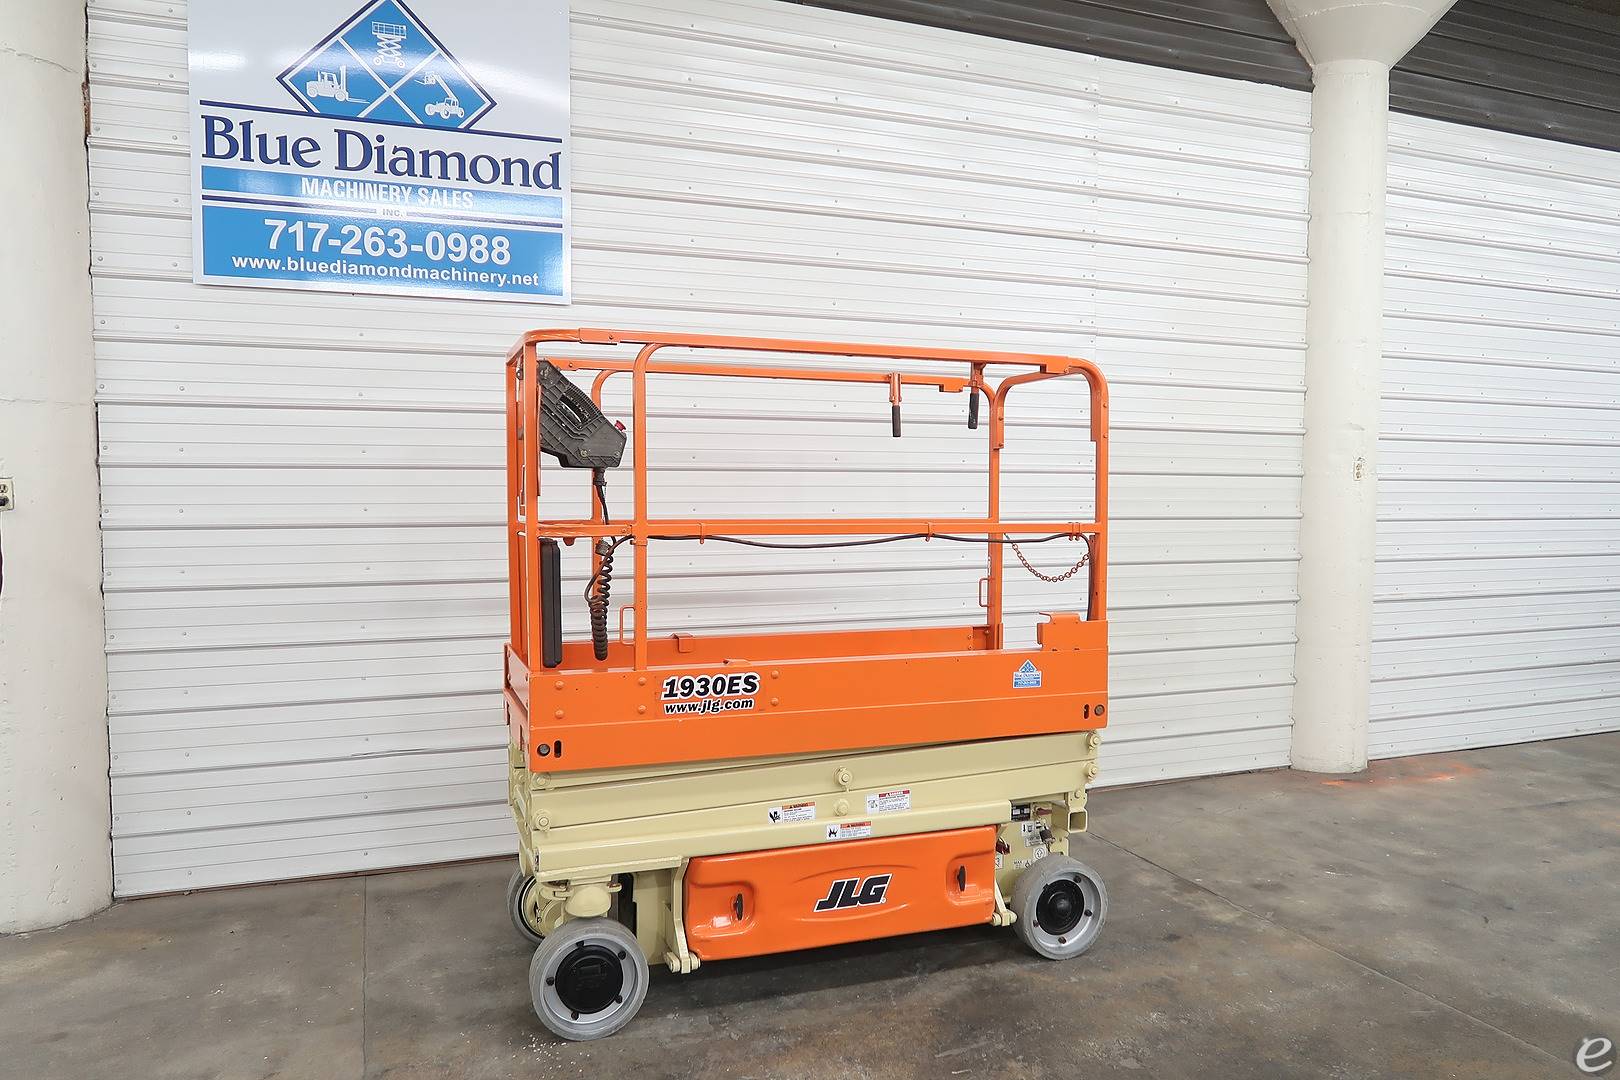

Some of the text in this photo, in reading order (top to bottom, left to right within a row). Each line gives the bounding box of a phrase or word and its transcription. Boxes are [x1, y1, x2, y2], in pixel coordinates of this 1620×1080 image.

[201, 114, 562, 190] Blue Diamond
[301, 177, 474, 210] MACHINERY SALES
[264, 218, 512, 266] 717-263-0988
[231, 254, 539, 287] www.bluediamondmachinery.net
[663, 673, 760, 699] 1930ES
[665, 699, 753, 714] www.jlg.com
[814, 873, 892, 912] JLG
